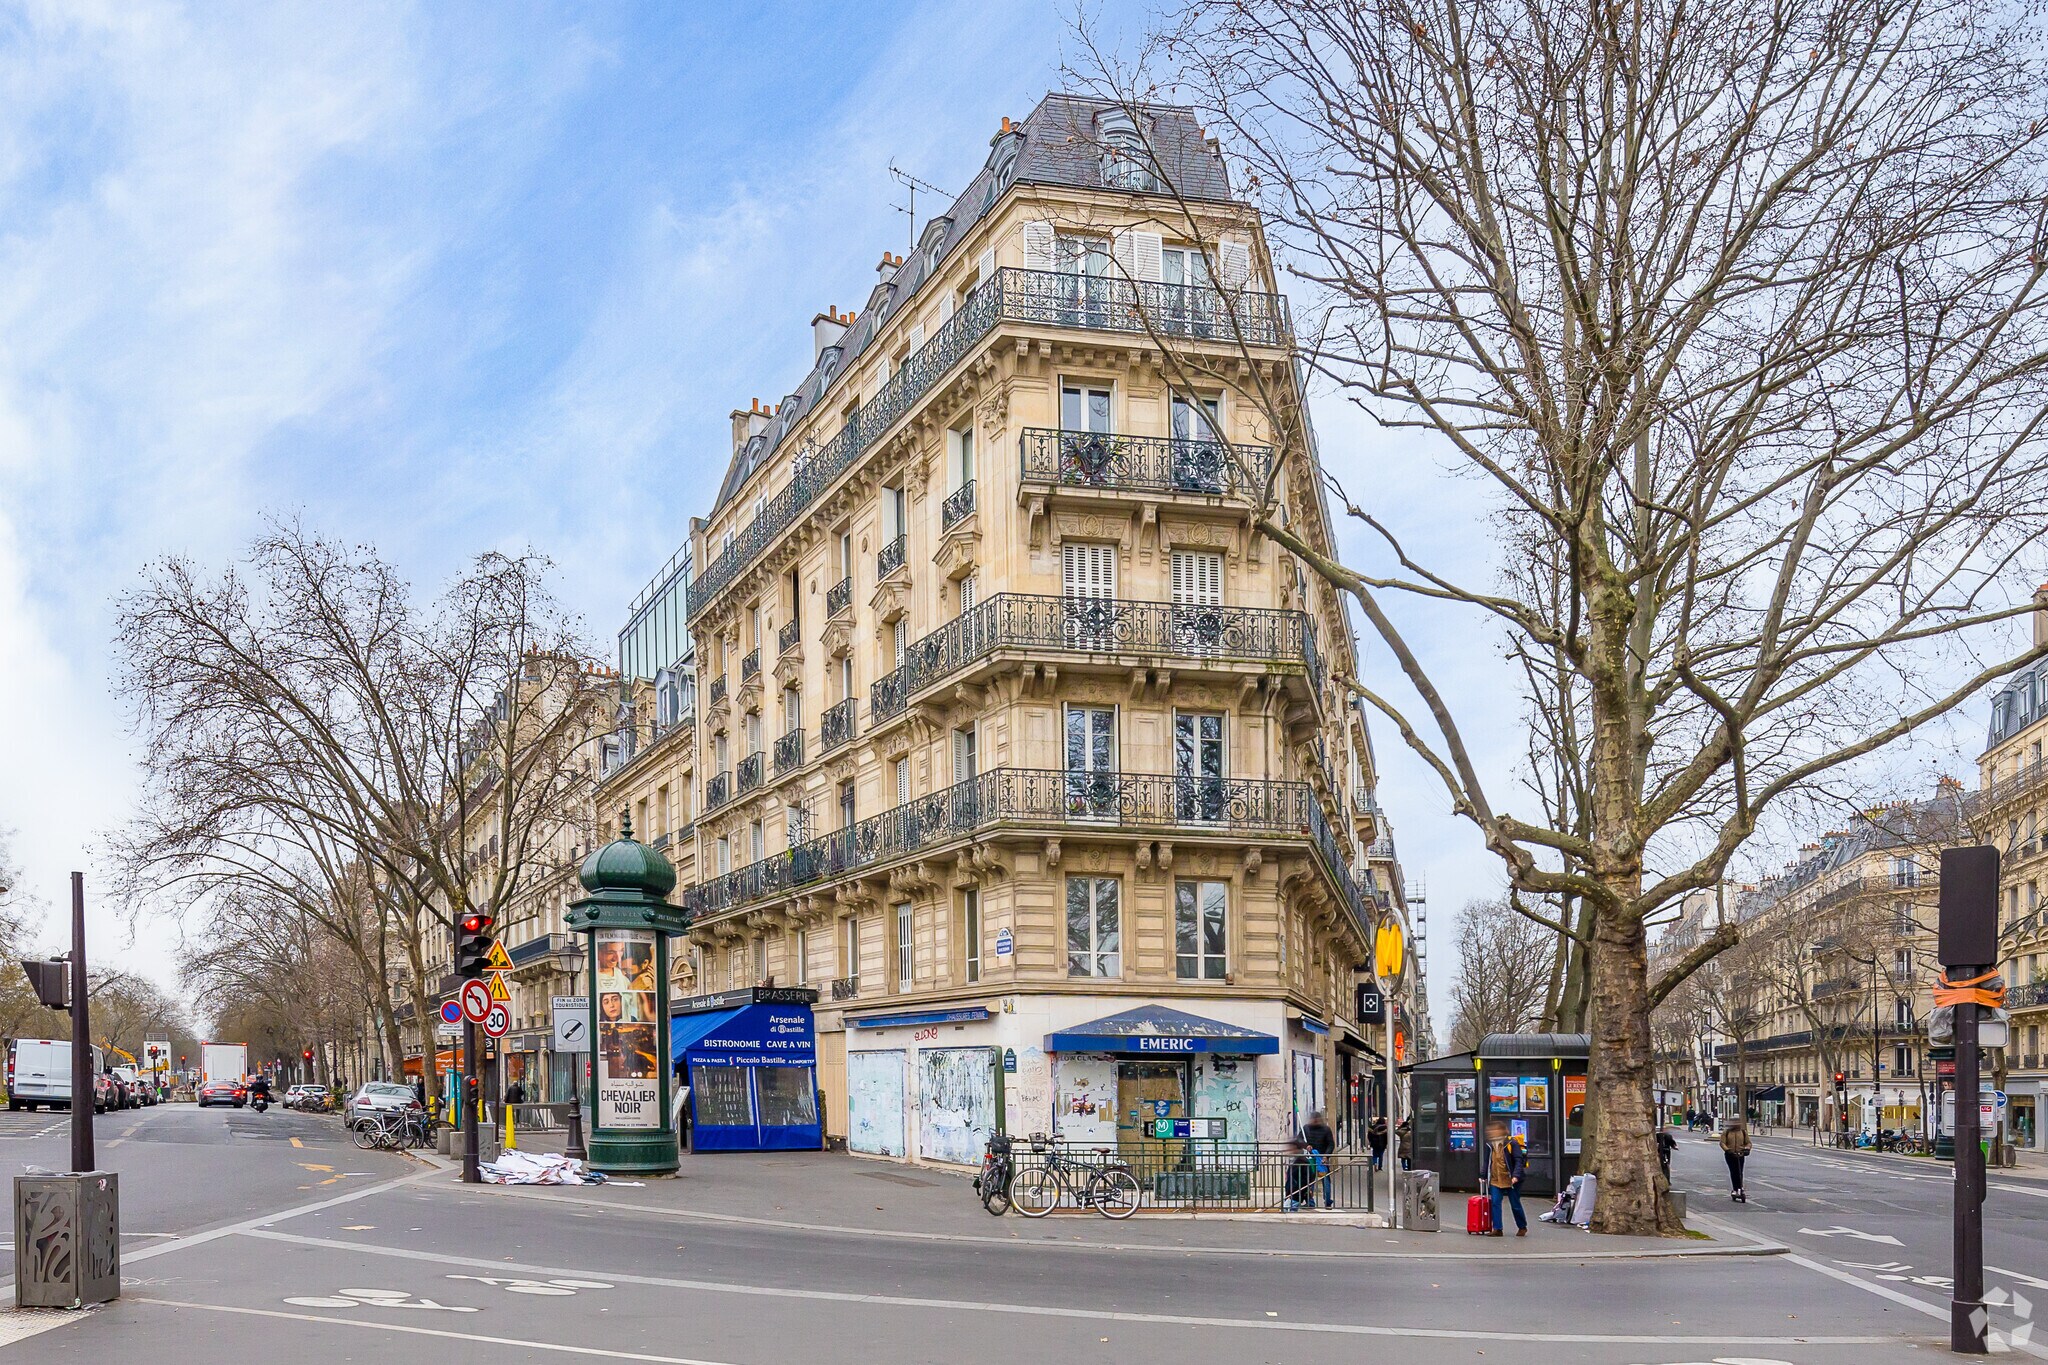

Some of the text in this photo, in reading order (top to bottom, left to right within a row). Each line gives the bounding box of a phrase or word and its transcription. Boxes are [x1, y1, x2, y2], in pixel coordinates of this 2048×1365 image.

[758, 989, 810, 1001] BRASSERIE
[488, 1012, 504, 1028] 30
[769, 1015, 805, 1024] Arsenale
[777, 1024, 805, 1034] Bastille
[704, 1039, 760, 1048] BISTRONOMIE
[766, 1040, 787, 1048] CAVE
[796, 1040, 811, 1048] VIN
[1140, 1037, 1194, 1051] EMERIC
[736, 1056, 760, 1064] Piccolo
[761, 1056, 786, 1064] Bastille
[601, 1090, 656, 1102] CHEVALIER
[614, 1102, 641, 1113] NOIR
[1157, 1121, 1166, 1130] M
